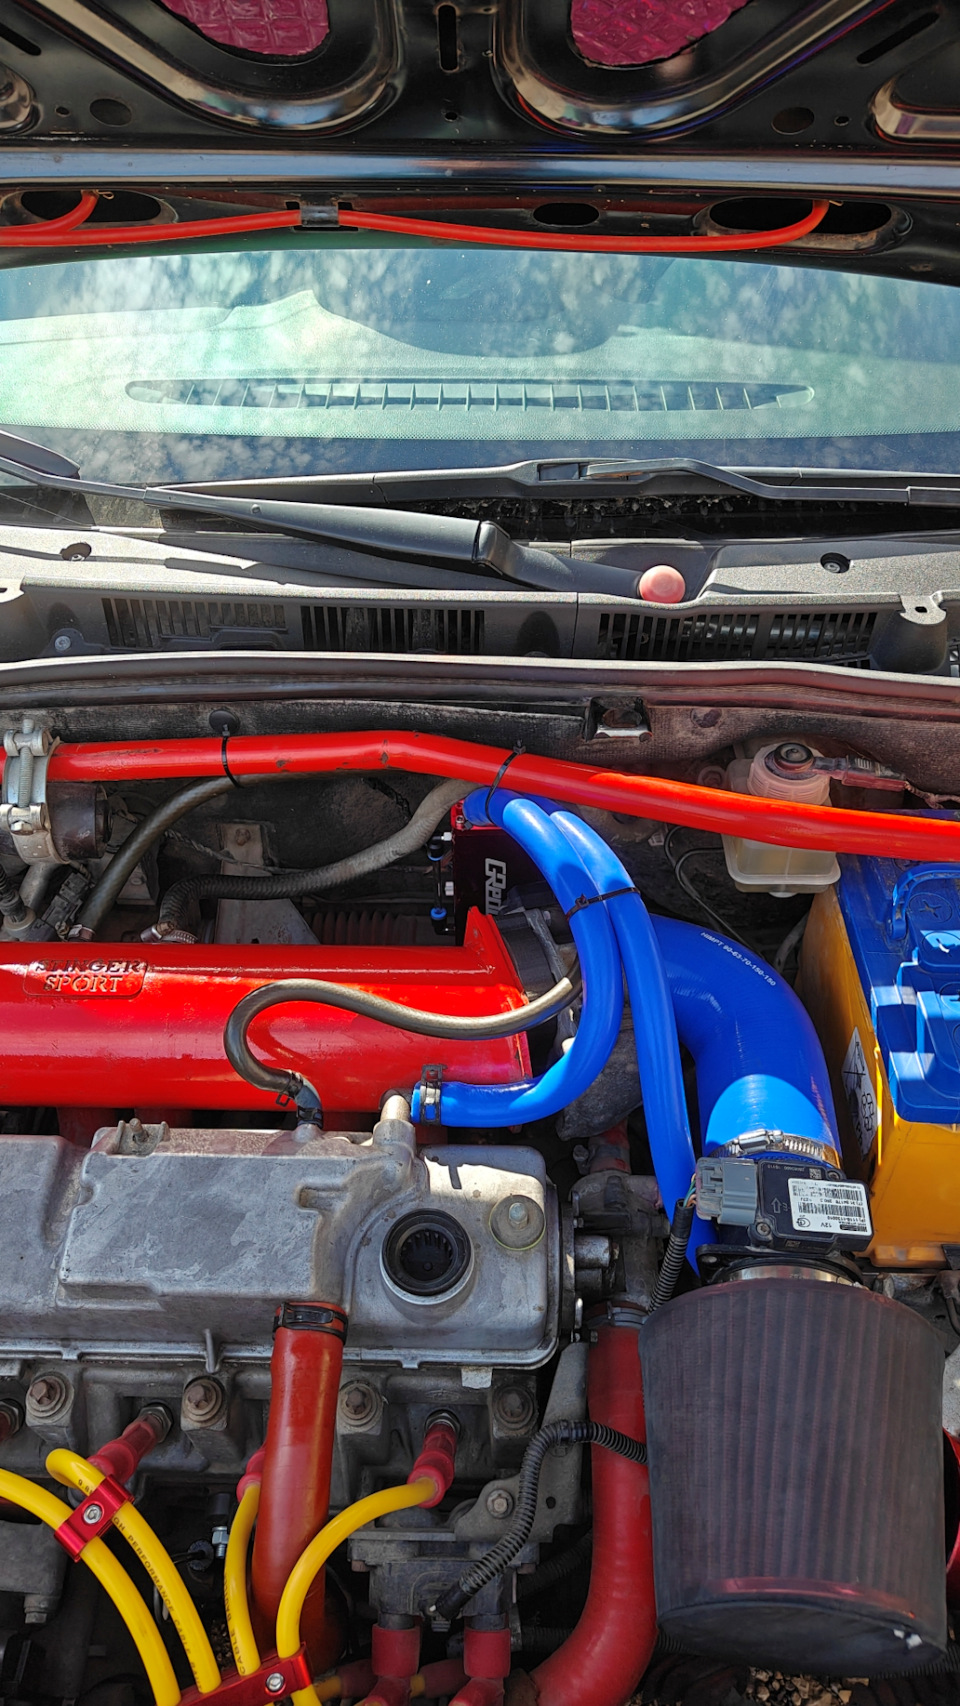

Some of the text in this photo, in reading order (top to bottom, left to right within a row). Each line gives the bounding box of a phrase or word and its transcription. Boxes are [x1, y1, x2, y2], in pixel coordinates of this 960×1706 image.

[36, 959, 142, 973] STINGER
[43, 974, 122, 992] SPORT
[128, 1535, 174, 1612] PERFORMANCE
[174, 1619, 191, 1654] CABLE
[231, 1630, 246, 1675] CABLE
